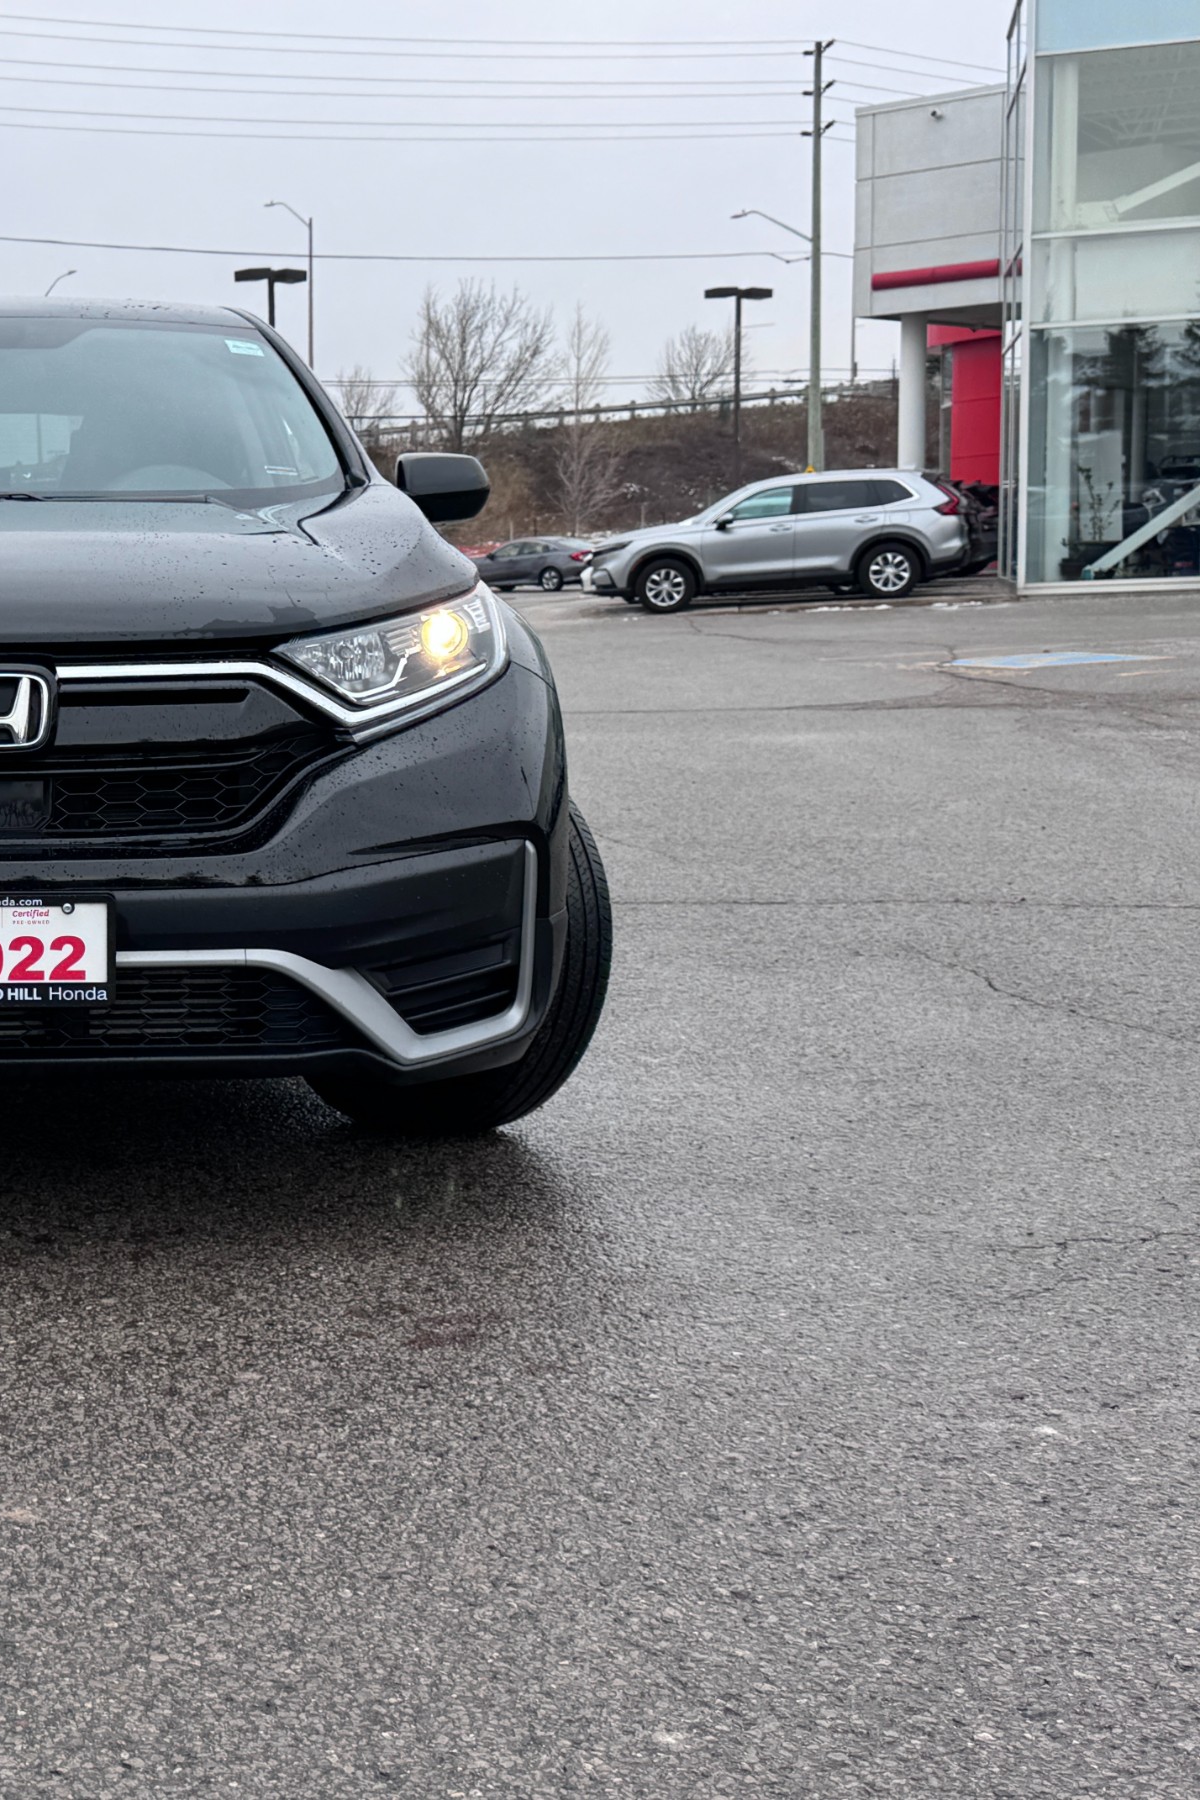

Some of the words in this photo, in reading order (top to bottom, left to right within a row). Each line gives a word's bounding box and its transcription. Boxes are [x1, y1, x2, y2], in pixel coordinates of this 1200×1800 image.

[12, 909, 50, 919] Certified
[7, 987, 42, 1001] HILL
[49, 986, 108, 1001] Honda
